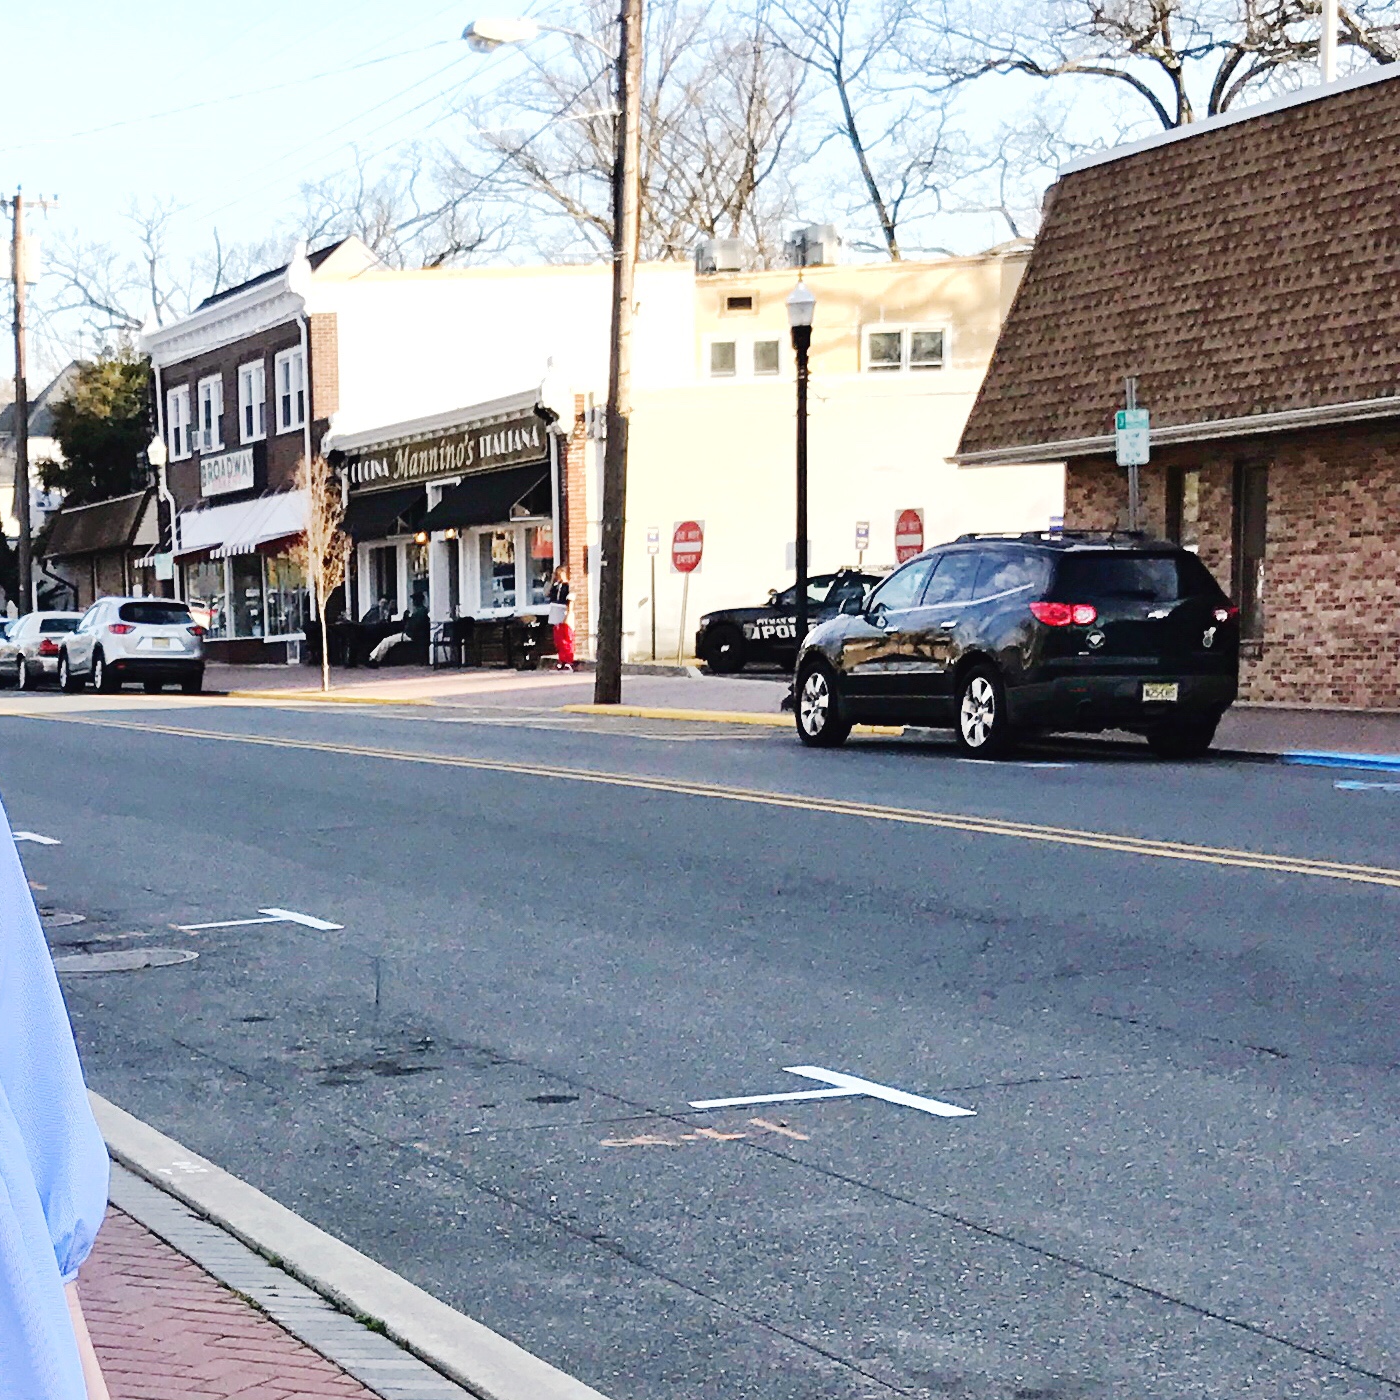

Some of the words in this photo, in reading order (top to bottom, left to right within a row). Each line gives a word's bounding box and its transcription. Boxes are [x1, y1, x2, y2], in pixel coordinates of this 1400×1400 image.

[201, 454, 253, 488] BROADWAY
[393, 433, 475, 480] Mannino's
[479, 425, 540, 458] ITALIANA
